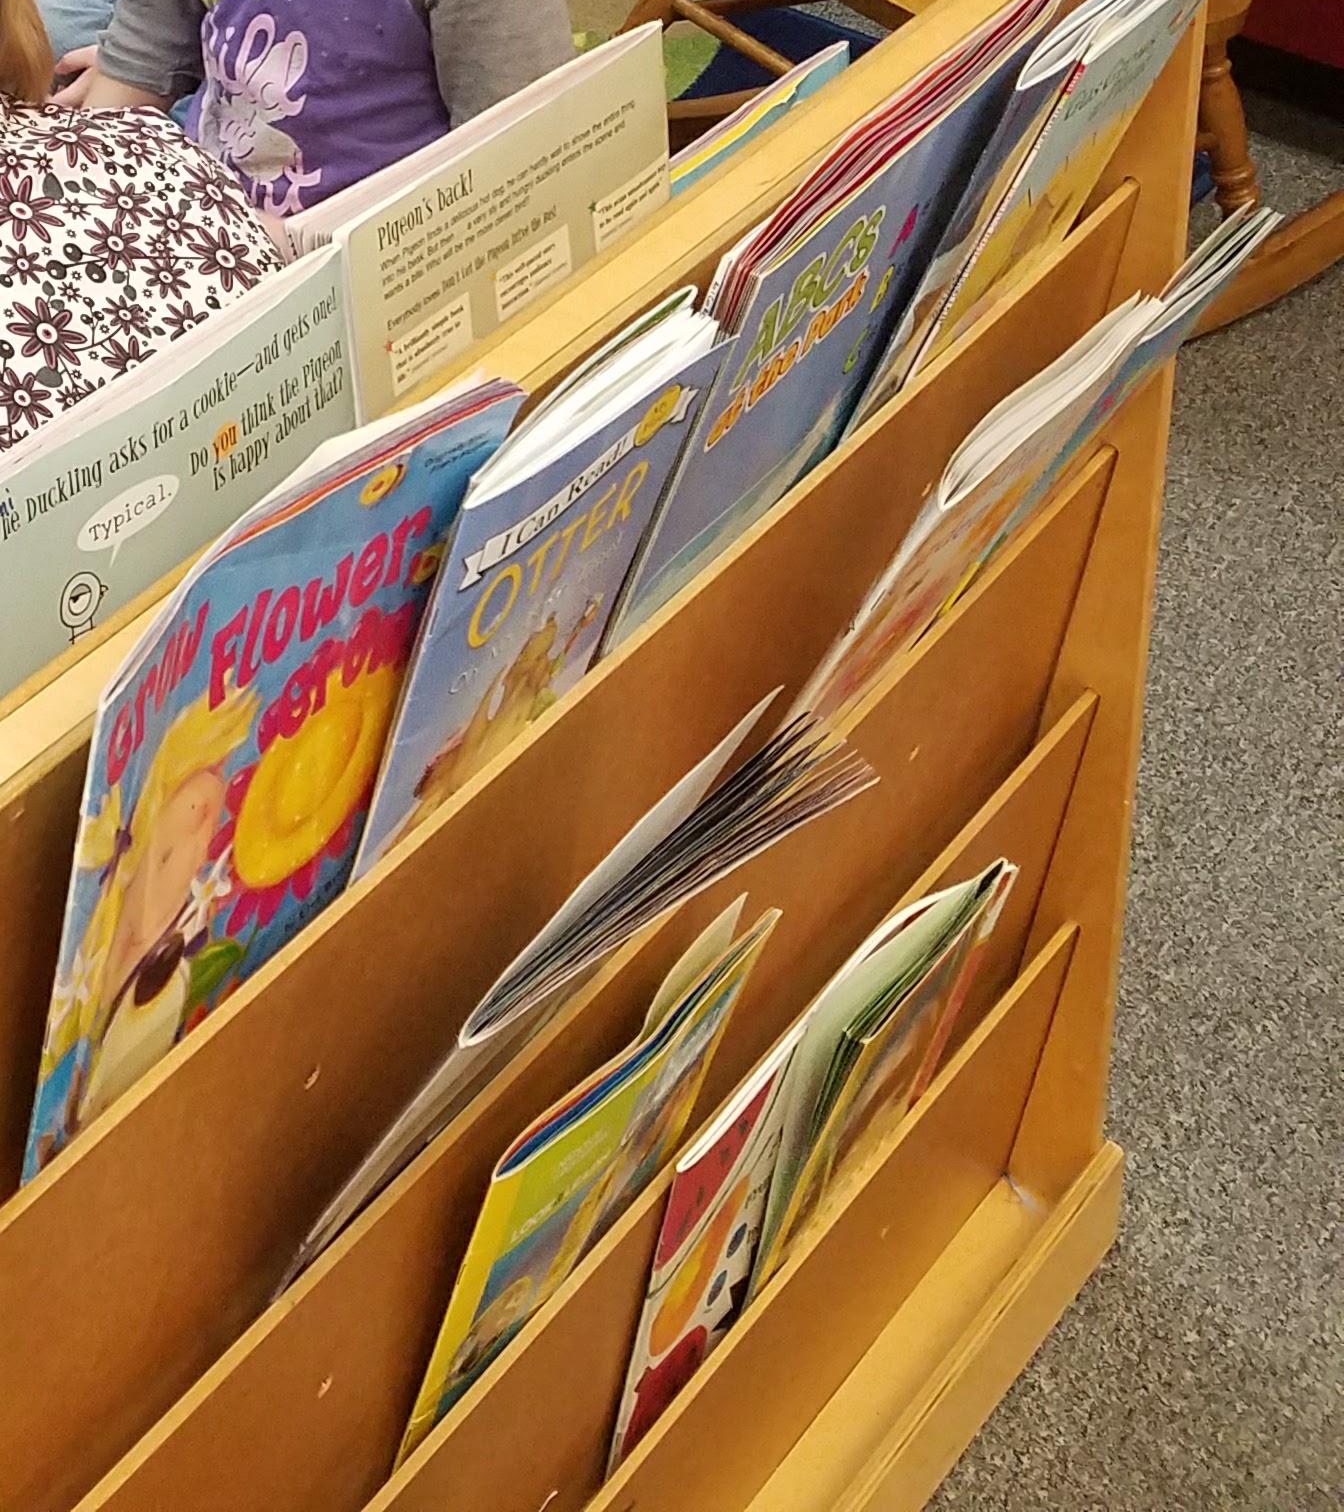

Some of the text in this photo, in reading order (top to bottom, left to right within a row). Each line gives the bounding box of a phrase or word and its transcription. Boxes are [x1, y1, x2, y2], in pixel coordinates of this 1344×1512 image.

[377, 168, 474, 252] Pigeon's back!
[705, 385, 747, 450] at
[747, 339, 801, 408] the
[800, 268, 868, 361] Park
[730, 205, 885, 395] ABCs
[26, 459, 103, 523] Duckling
[108, 433, 148, 475] asks
[153, 416, 175, 449] for
[179, 408, 189, 431] a
[282, 313, 310, 356] gets
[312, 286, 337, 327] one!
[212, 419, 239, 465] you
[240, 392, 277, 438] think
[279, 374, 300, 408] the
[302, 339, 343, 389] Pigeon
[213, 366, 343, 491] is happy about that?
[88, 483, 174, 541] Typical.
[468, 460, 649, 650] OTTER
[499, 436, 629, 557] I Can Read!
[104, 598, 210, 787] Grow
[208, 505, 433, 713] Flower,
